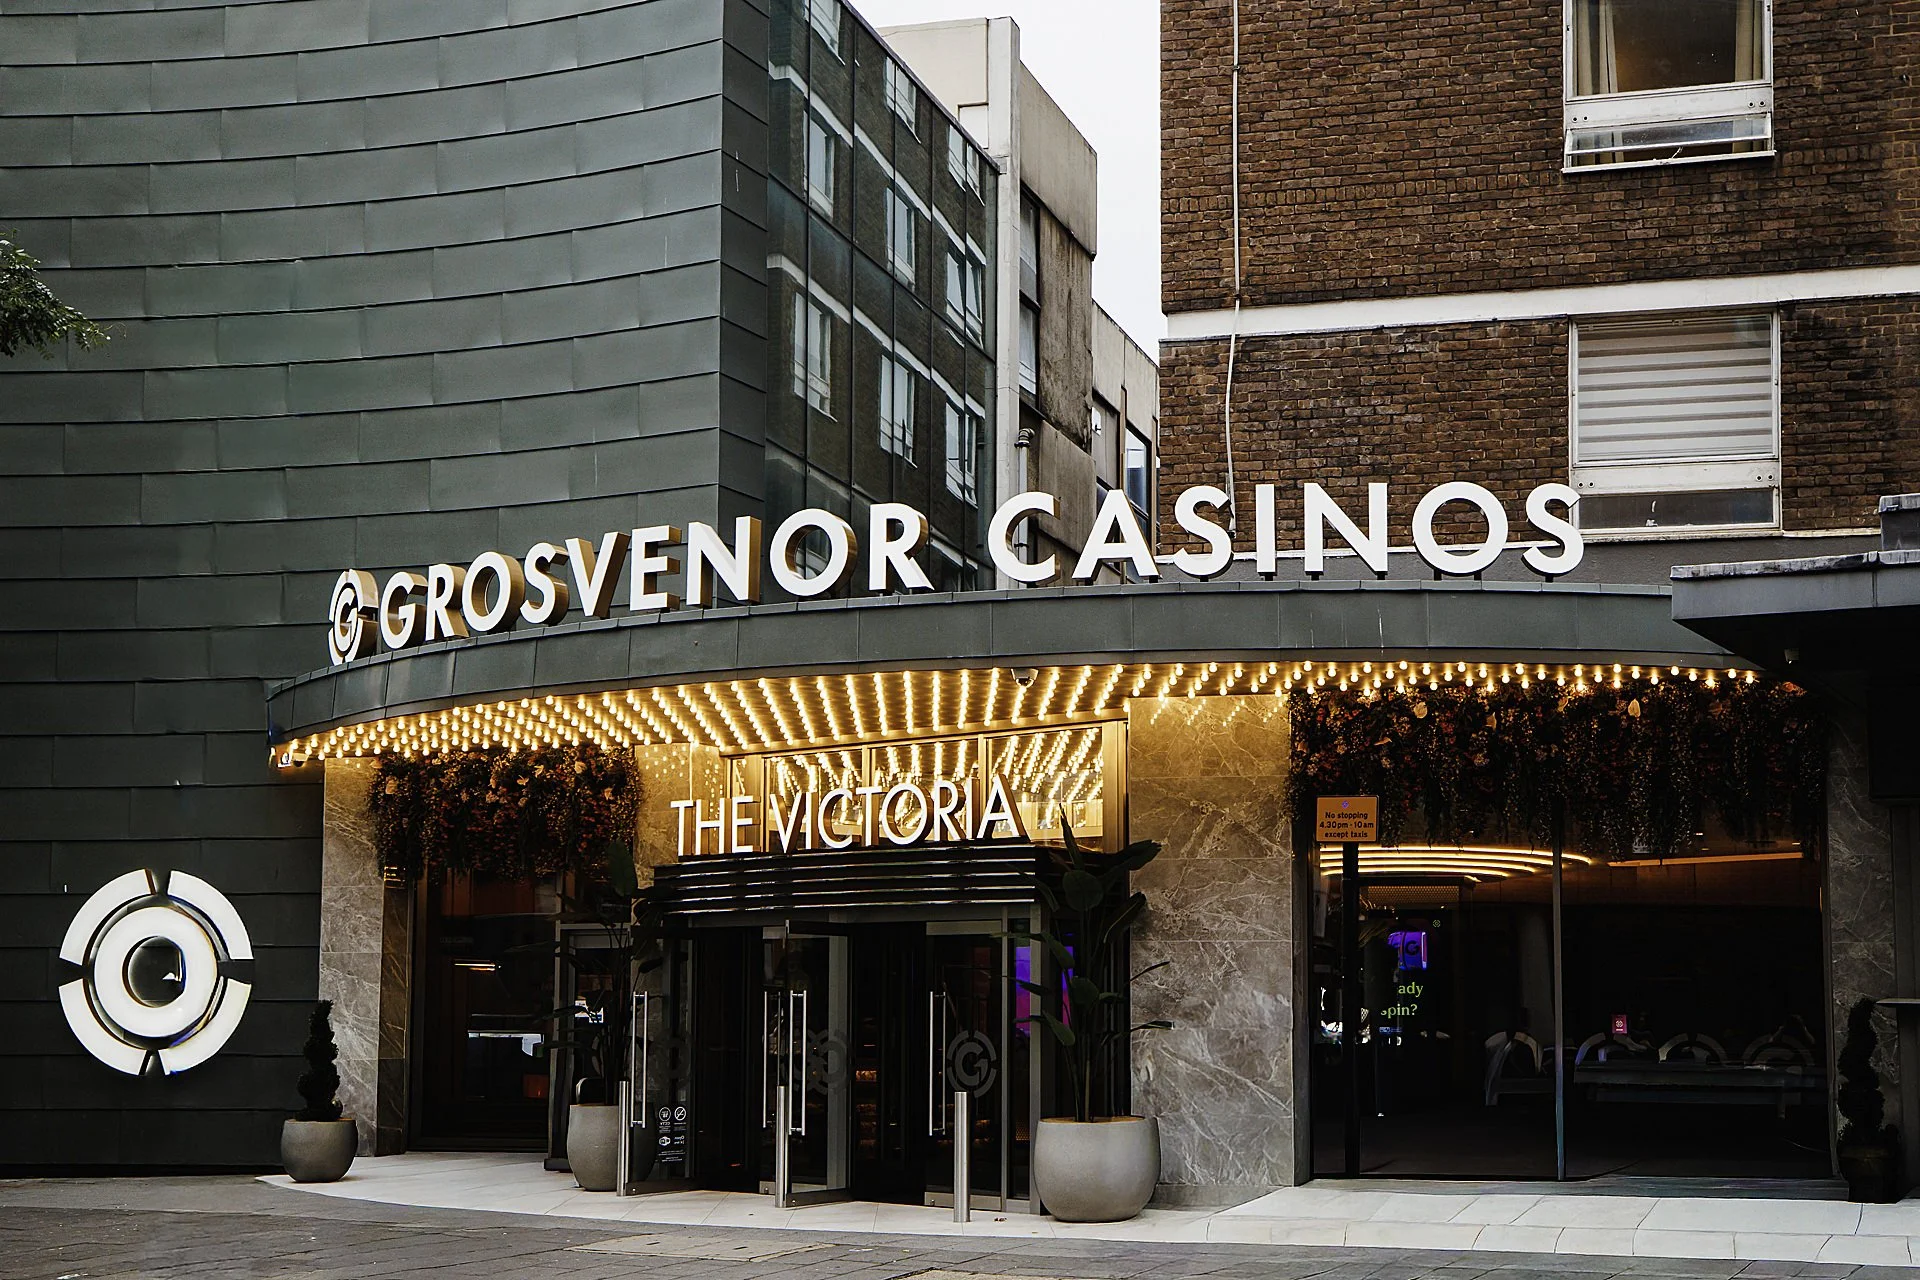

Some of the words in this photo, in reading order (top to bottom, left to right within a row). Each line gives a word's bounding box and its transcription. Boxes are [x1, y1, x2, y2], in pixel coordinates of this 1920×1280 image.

[380, 502, 934, 649] GROSVENOR
[988, 481, 1585, 582] CASINOS
[670, 794, 758, 856] THE
[770, 774, 1026, 854] VICTORIA
[1398, 982, 1423, 998] ady
